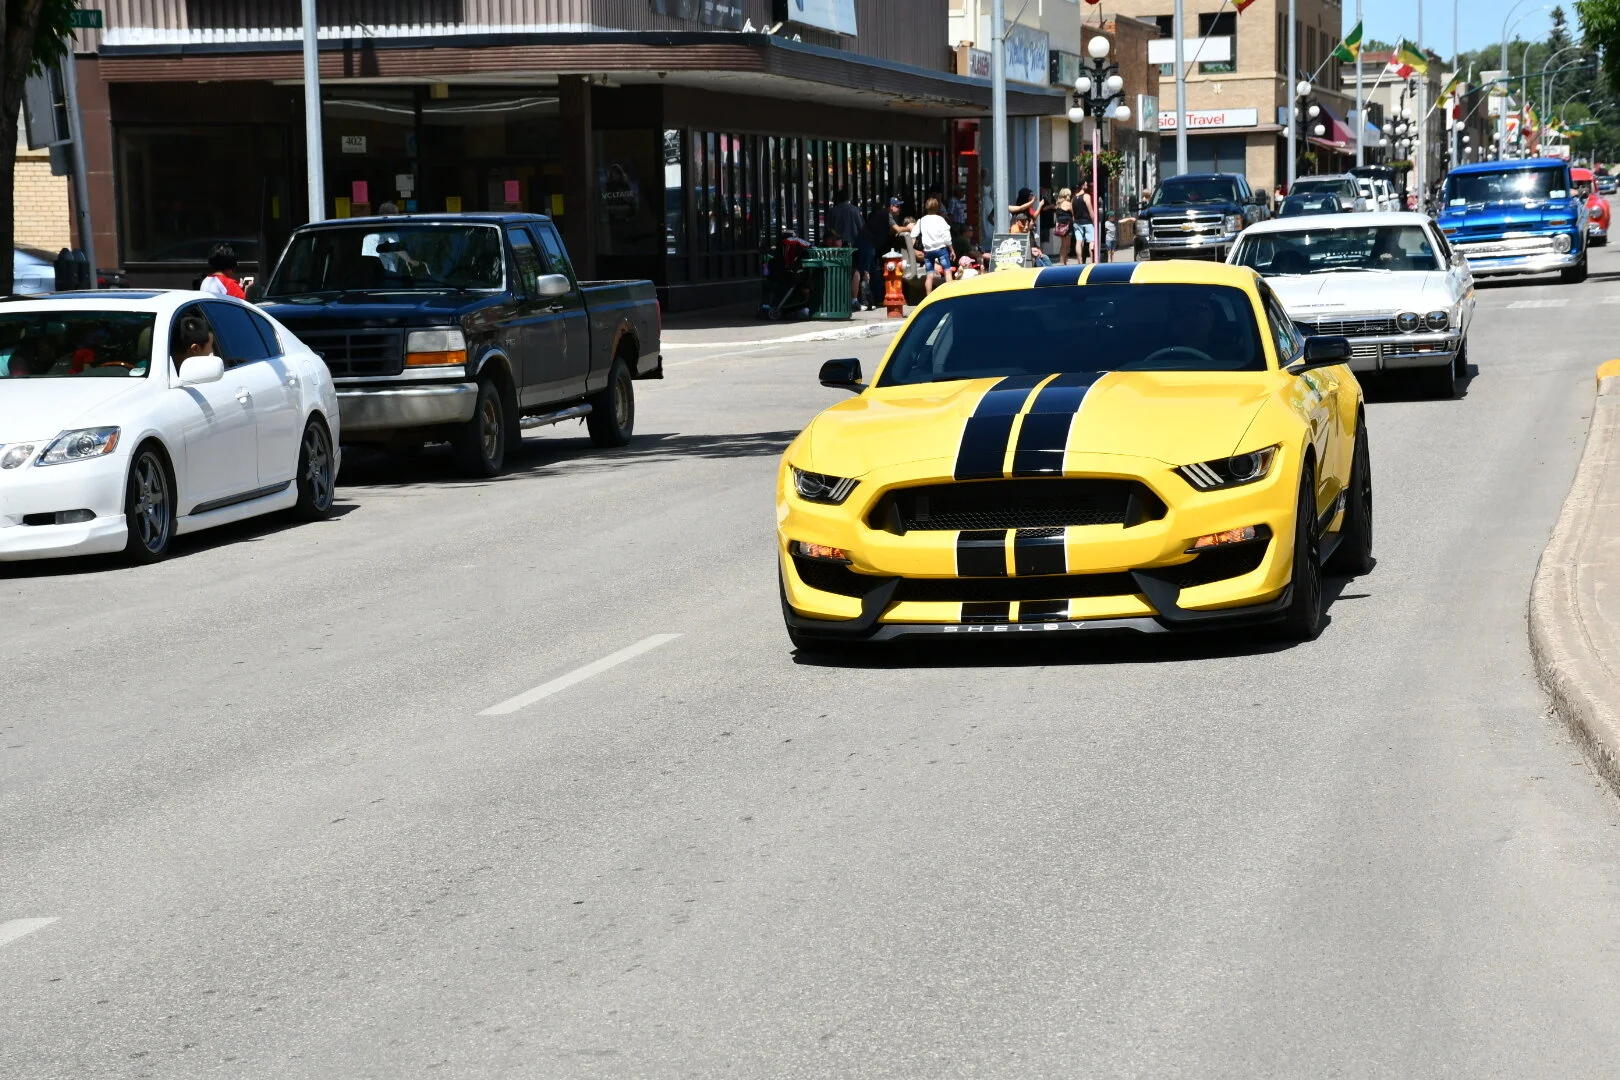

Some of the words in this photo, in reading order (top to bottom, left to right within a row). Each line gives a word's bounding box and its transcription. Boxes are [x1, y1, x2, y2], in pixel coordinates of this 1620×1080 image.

[88, 12, 97, 25] W
[1186, 114, 1225, 126] Travel
[345, 136, 362, 146] 402
[943, 621, 1086, 633] SHELBY
